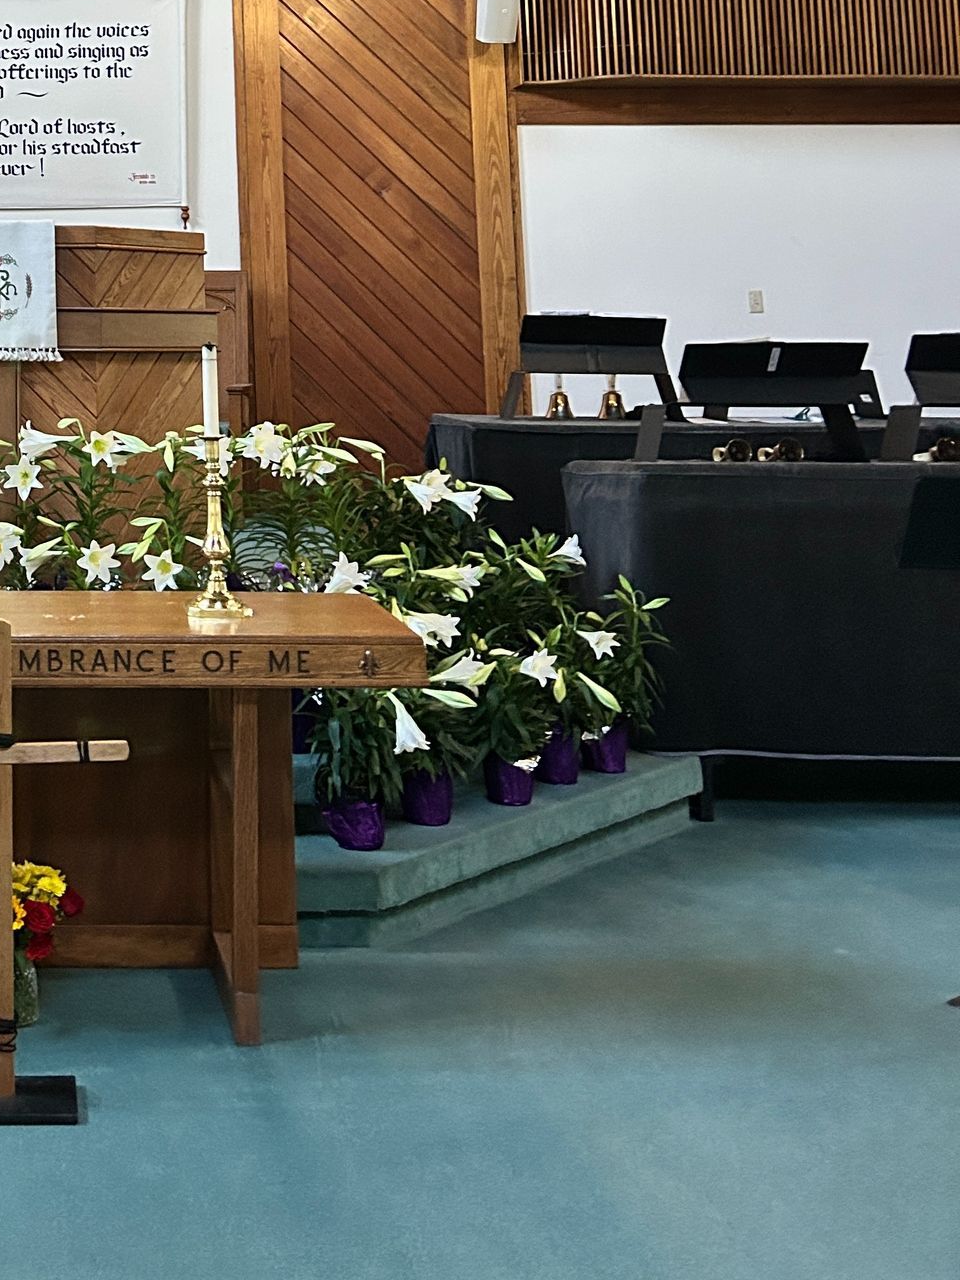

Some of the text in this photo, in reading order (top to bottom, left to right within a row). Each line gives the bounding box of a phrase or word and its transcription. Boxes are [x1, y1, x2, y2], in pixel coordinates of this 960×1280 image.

[16, 24, 60, 43] again
[64, 22, 91, 39] the
[96, 23, 151, 38] voices
[34, 43, 64, 59] and
[67, 43, 125, 63] singing
[129, 44, 149, 58] as
[83, 65, 101, 79] to
[105, 62, 133, 79] the
[43, 118, 63, 135] of
[22, 139, 47, 156] his
[51, 138, 142, 155] steadfast
[201, 650, 243, 673] OF
[268, 650, 311, 674] ME
